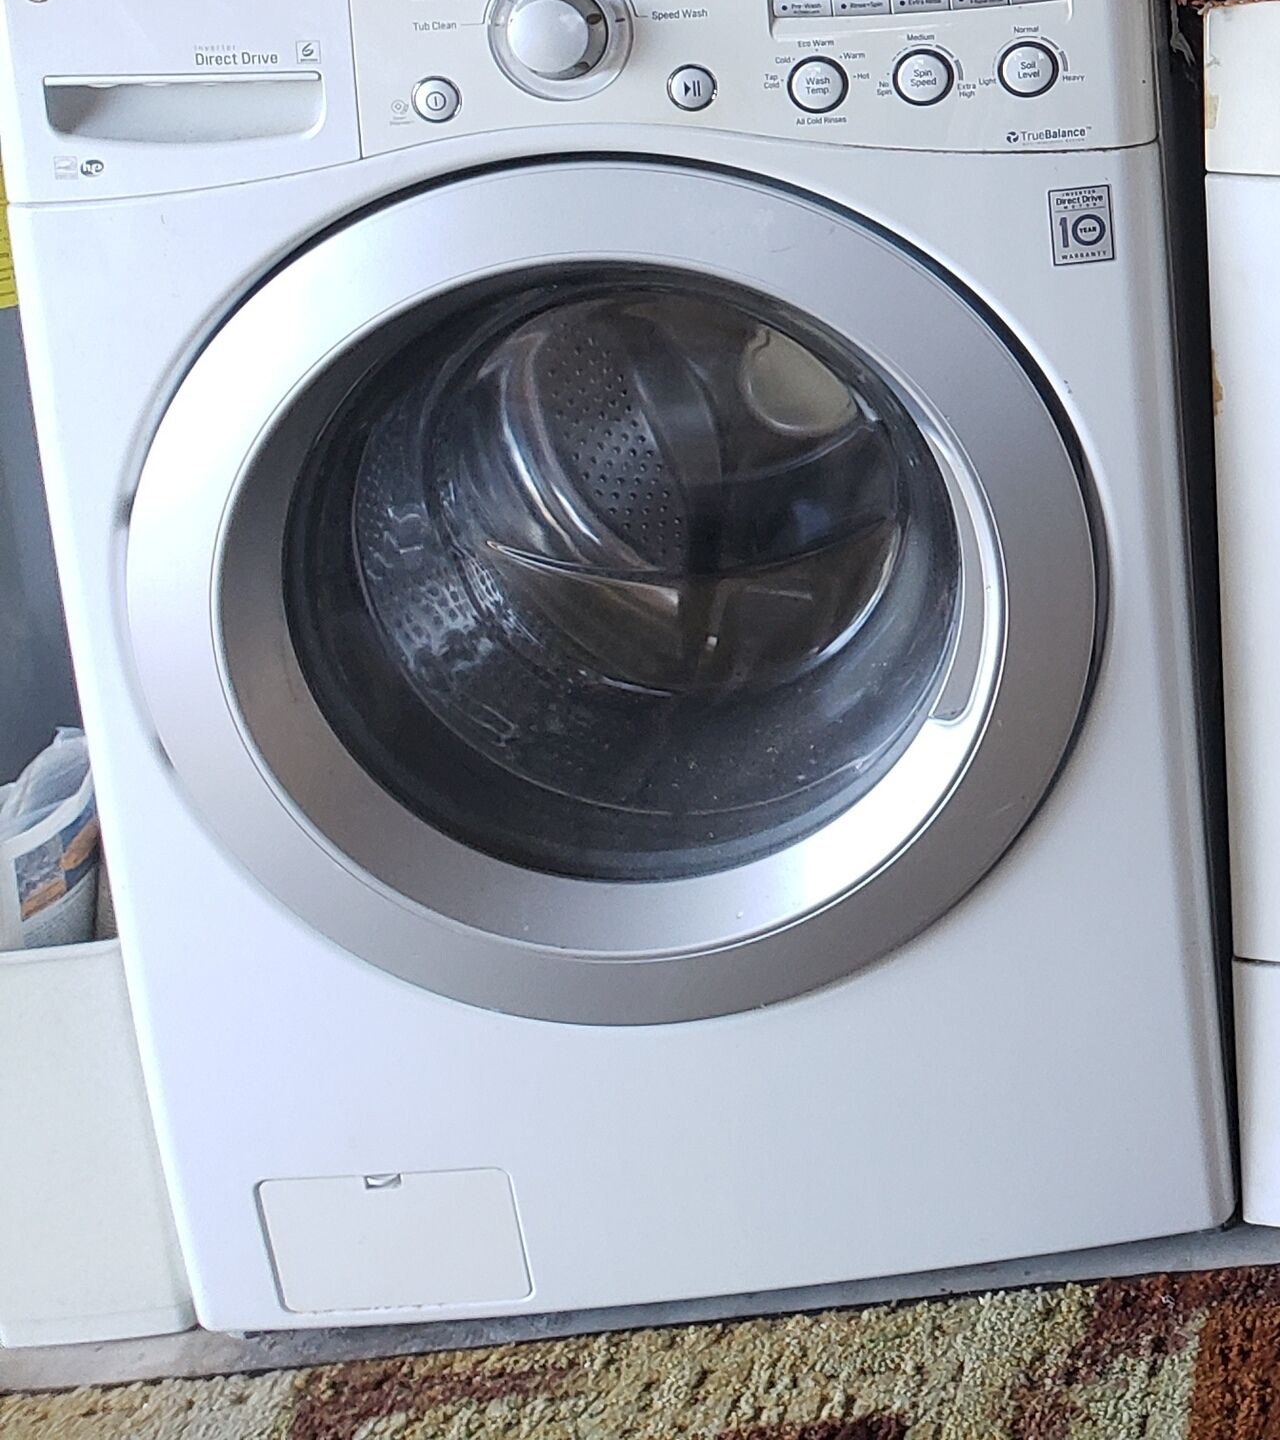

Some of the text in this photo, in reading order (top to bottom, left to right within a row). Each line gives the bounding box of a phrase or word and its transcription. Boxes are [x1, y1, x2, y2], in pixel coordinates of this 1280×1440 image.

[652, 8, 708, 22] Speed Wash
[413, 19, 457, 31] Tub Clean
[1013, 25, 1040, 34] Normal
[906, 32, 935, 42] Medium
[797, 38, 835, 48] Eco Warm
[195, 51, 279, 66] Direct Drive
[775, 56, 792, 65] Cold
[843, 51, 866, 60] Warm
[1020, 61, 1037, 71] Soil
[764, 74, 778, 83] Tap
[857, 72, 870, 80] Hot
[913, 68, 933, 80] Spin
[1016, 69, 1040, 79] Level
[763, 81, 780, 90] Cold
[805, 76, 831, 86] Wash
[878, 81, 889, 89] No
[910, 76, 937, 88] Speed
[978, 77, 997, 87] Light
[806, 85, 832, 97] Temp.
[957, 83, 976, 91] Extra
[876, 88, 893, 97] Spin
[958, 89, 976, 99] High
[796, 117, 806, 125] All
[806, 116, 823, 125] Cold
[1056, 194, 1104, 206] Direct Drive
[1061, 250, 1107, 260] WARRANTY
